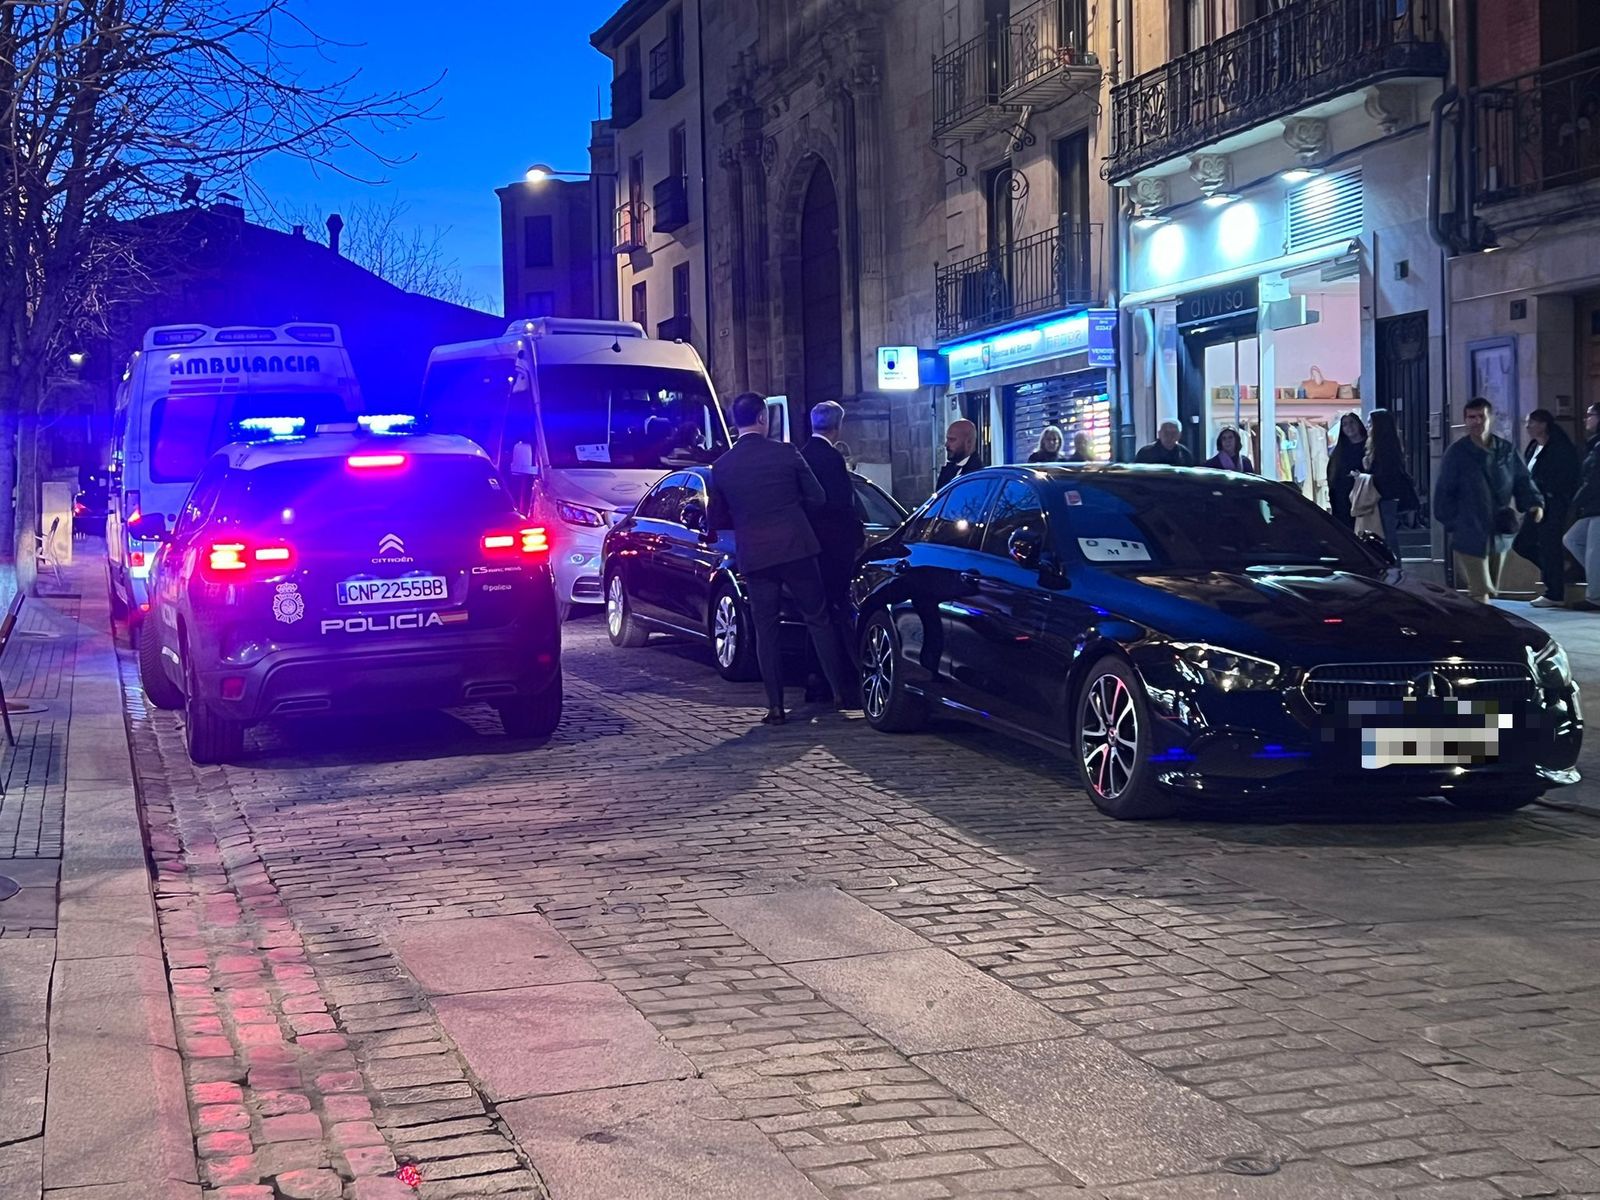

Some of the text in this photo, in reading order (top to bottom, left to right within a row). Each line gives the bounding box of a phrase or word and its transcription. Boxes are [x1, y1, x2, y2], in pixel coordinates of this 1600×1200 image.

[169, 355, 320, 375] AMBULANCIA
[347, 579, 444, 601] CNP2255BB
[320, 612, 444, 635] POLICIA
